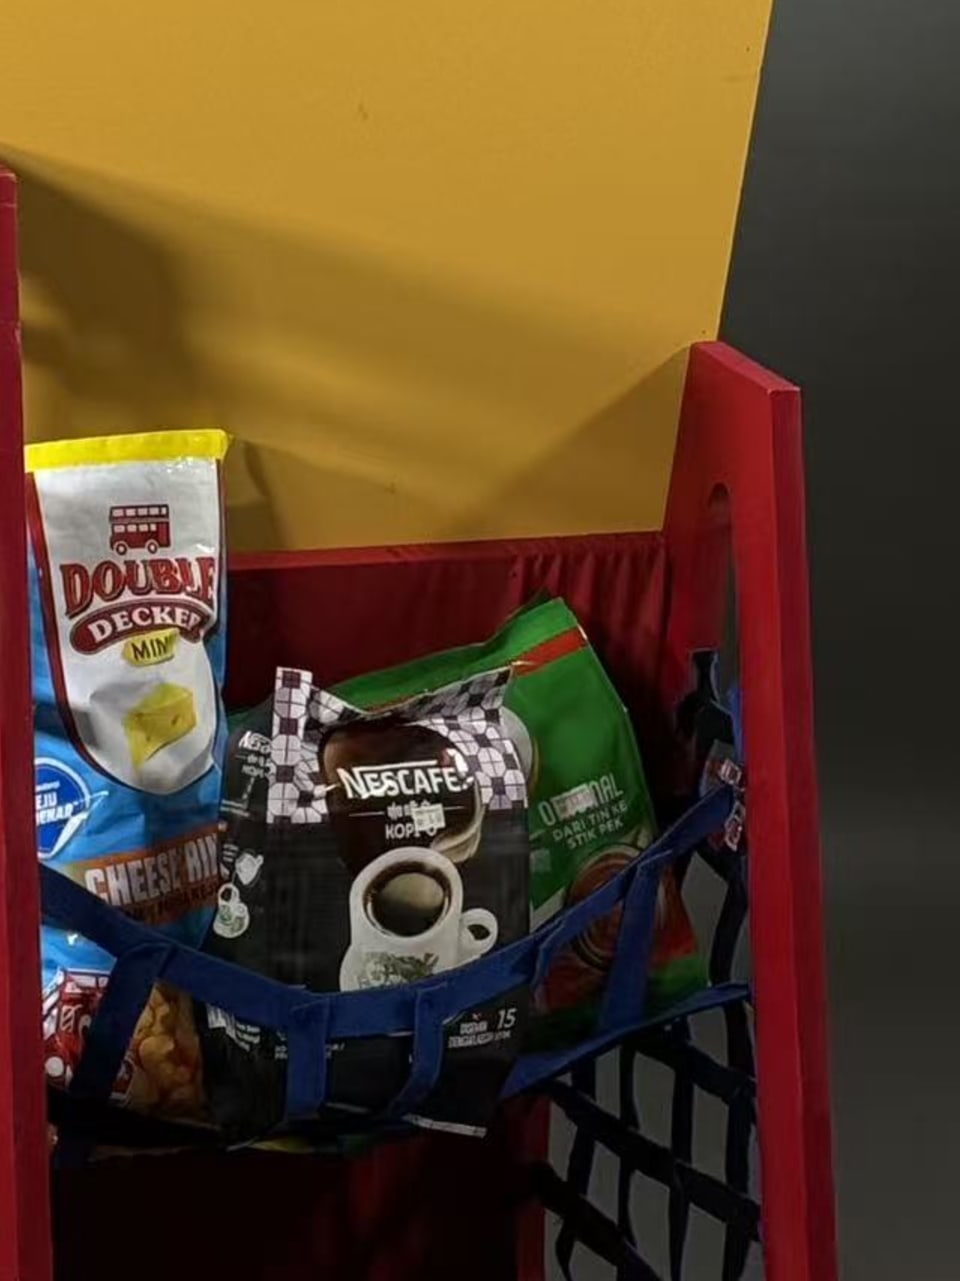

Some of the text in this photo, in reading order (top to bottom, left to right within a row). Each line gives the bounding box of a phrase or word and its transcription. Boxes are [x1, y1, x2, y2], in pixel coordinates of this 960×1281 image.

[131, 636, 172, 661] MIN
[84, 847, 184, 907] CHEESE
[497, 1007, 518, 1029] 15
